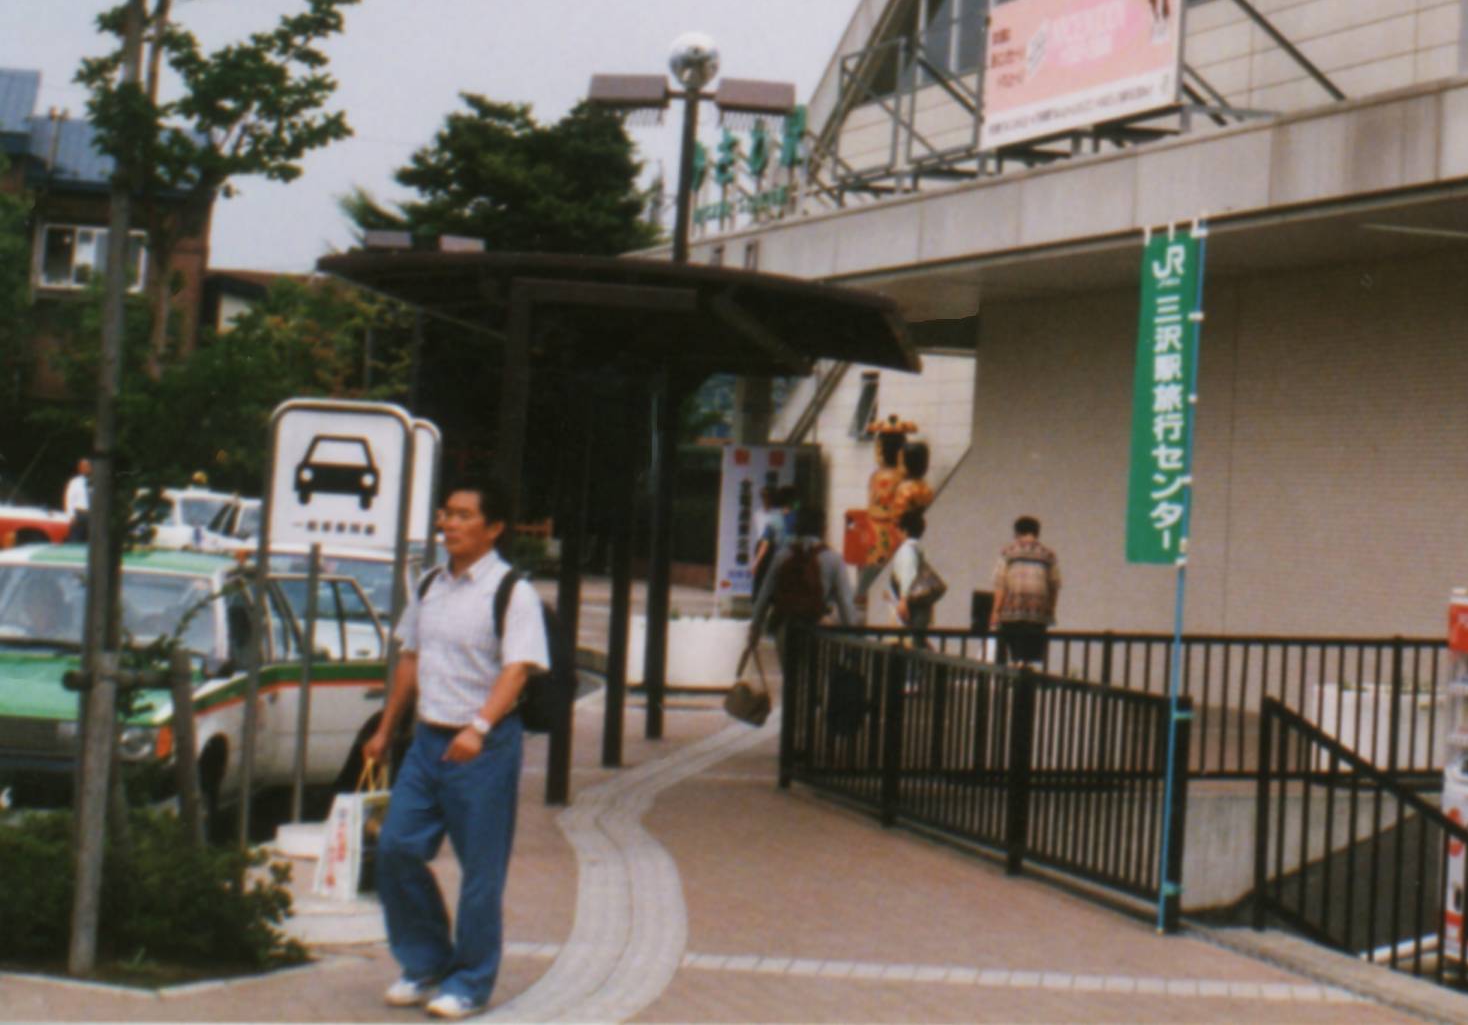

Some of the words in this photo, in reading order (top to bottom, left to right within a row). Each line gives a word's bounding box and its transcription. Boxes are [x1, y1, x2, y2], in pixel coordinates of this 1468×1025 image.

[1152, 244, 1185, 279] JR
[1151, 295, 1184, 550] 三沢駅旅行センター
